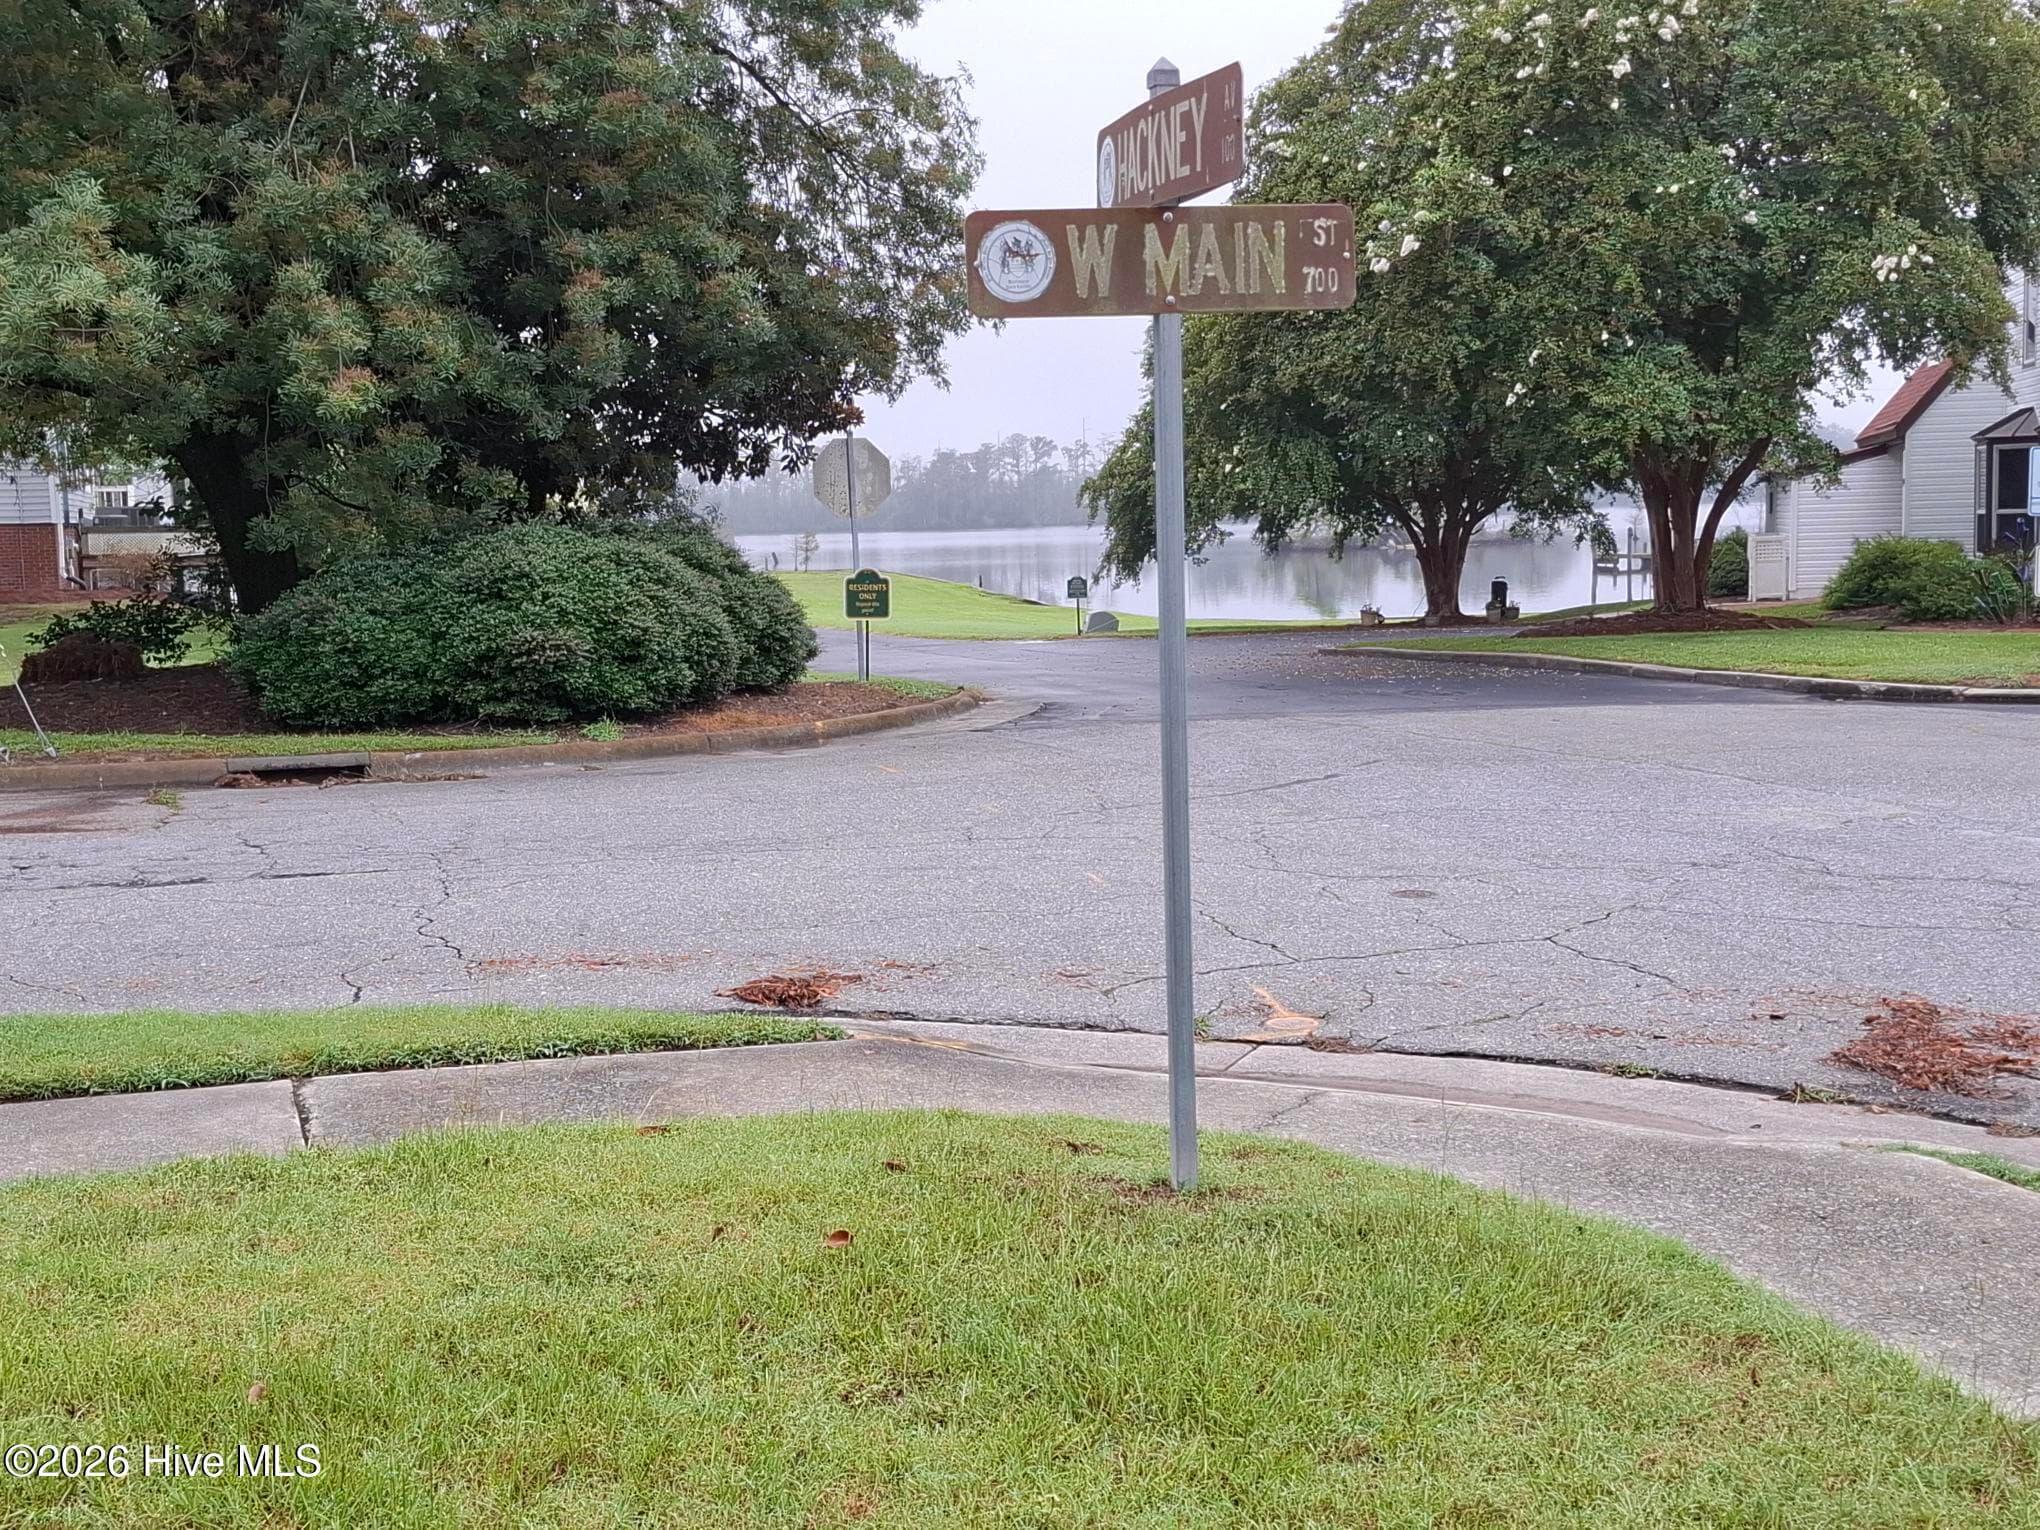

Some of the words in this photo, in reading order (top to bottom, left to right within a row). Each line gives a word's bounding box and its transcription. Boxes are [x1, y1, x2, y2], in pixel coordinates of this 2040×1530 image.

[1118, 93, 1207, 203] HACKNEY
[1224, 80, 1237, 111] AV
[1221, 133, 1236, 164] 100
[1066, 223, 1118, 298] W
[1142, 220, 1287, 297] MAIN
[1312, 218, 1338, 247] ST
[1301, 266, 1339, 294] 700
[848, 583, 888, 591] RESIDENTS
[859, 592, 877, 600] ONLY
